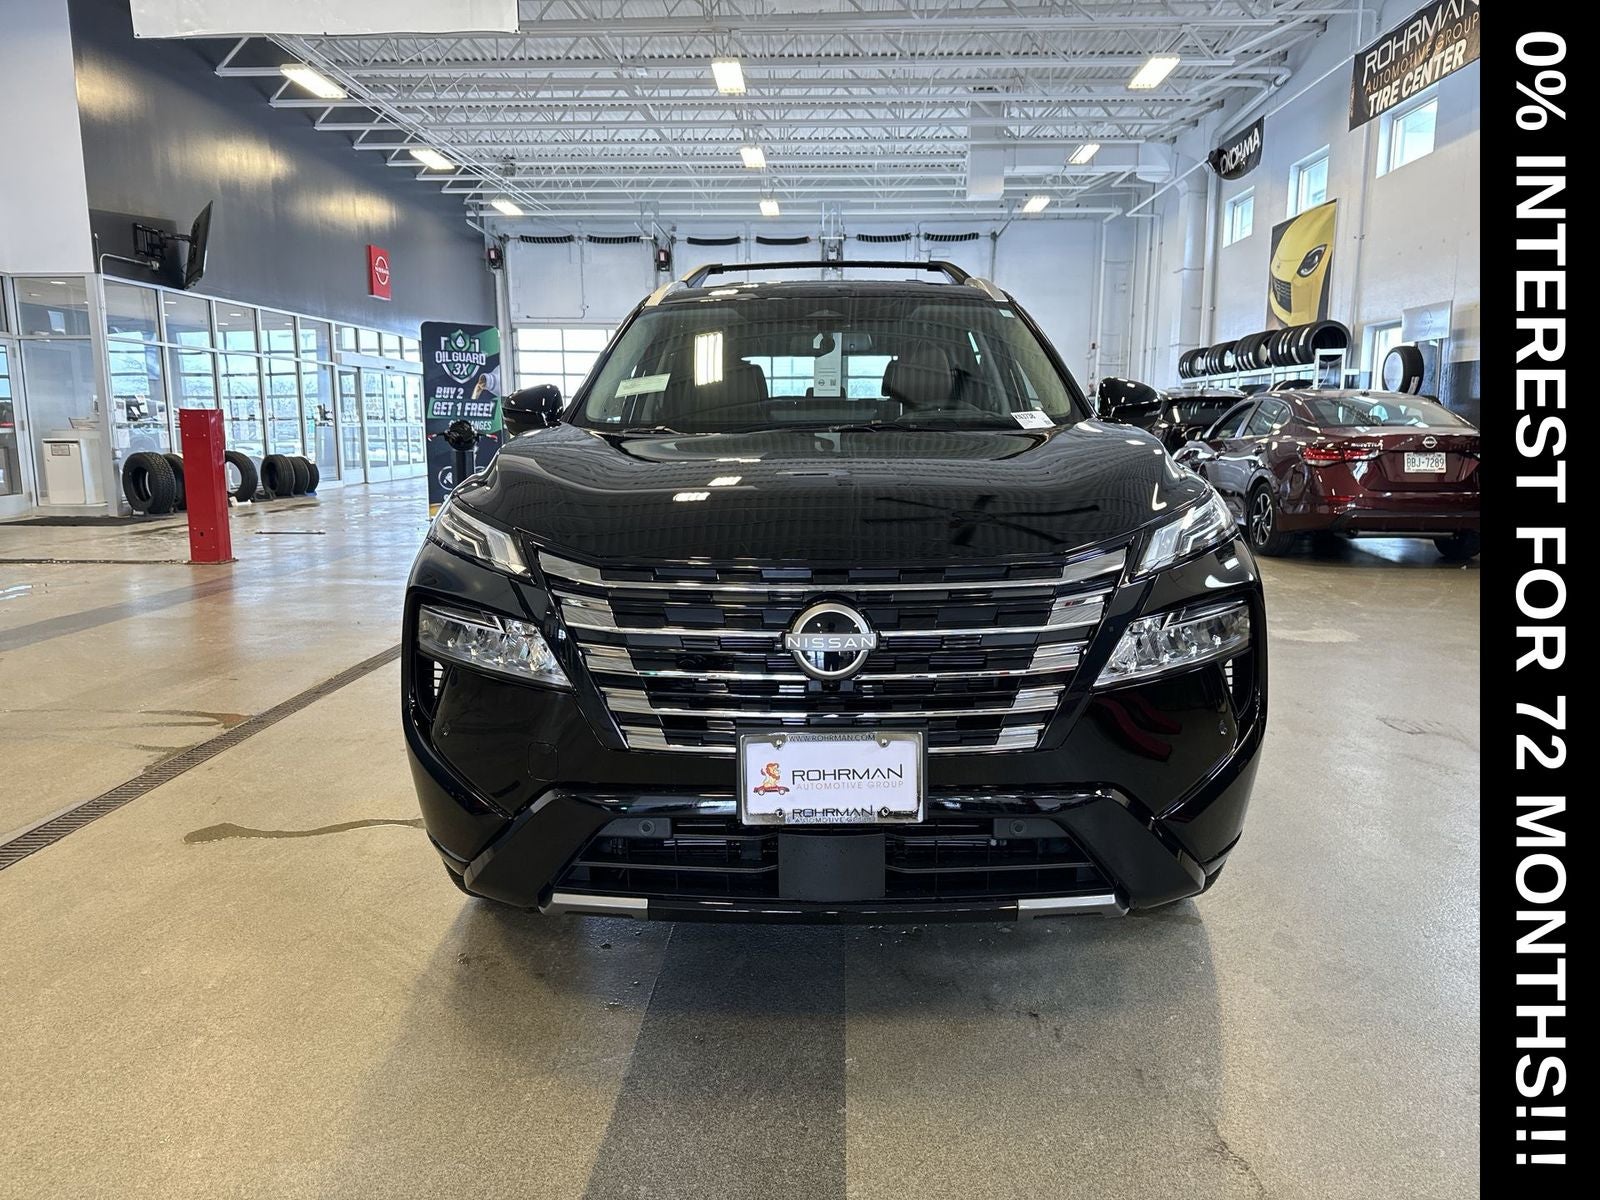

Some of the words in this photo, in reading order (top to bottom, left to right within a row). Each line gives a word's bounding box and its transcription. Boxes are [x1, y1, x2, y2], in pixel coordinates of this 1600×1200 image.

[1365, 41, 1431, 95] AUTOMOTIVE
[1435, 11, 1480, 51] GROUP
[1368, 79, 1400, 117] TIRE
[1401, 39, 1467, 98] CENTER
[453, 363, 469, 375] 3X
[435, 386, 456, 399] BUY
[456, 387, 464, 399] 2
[433, 401, 454, 416] GET
[456, 402, 462, 416] 1
[464, 401, 495, 417] FREE!
[787, 636, 874, 648] NISSAN
[792, 763, 903, 785] ROHRMAN
[796, 782, 862, 791] AUTOMOTIVE
[866, 780, 904, 789] GROUP
[792, 804, 873, 820] ROHRMAN
